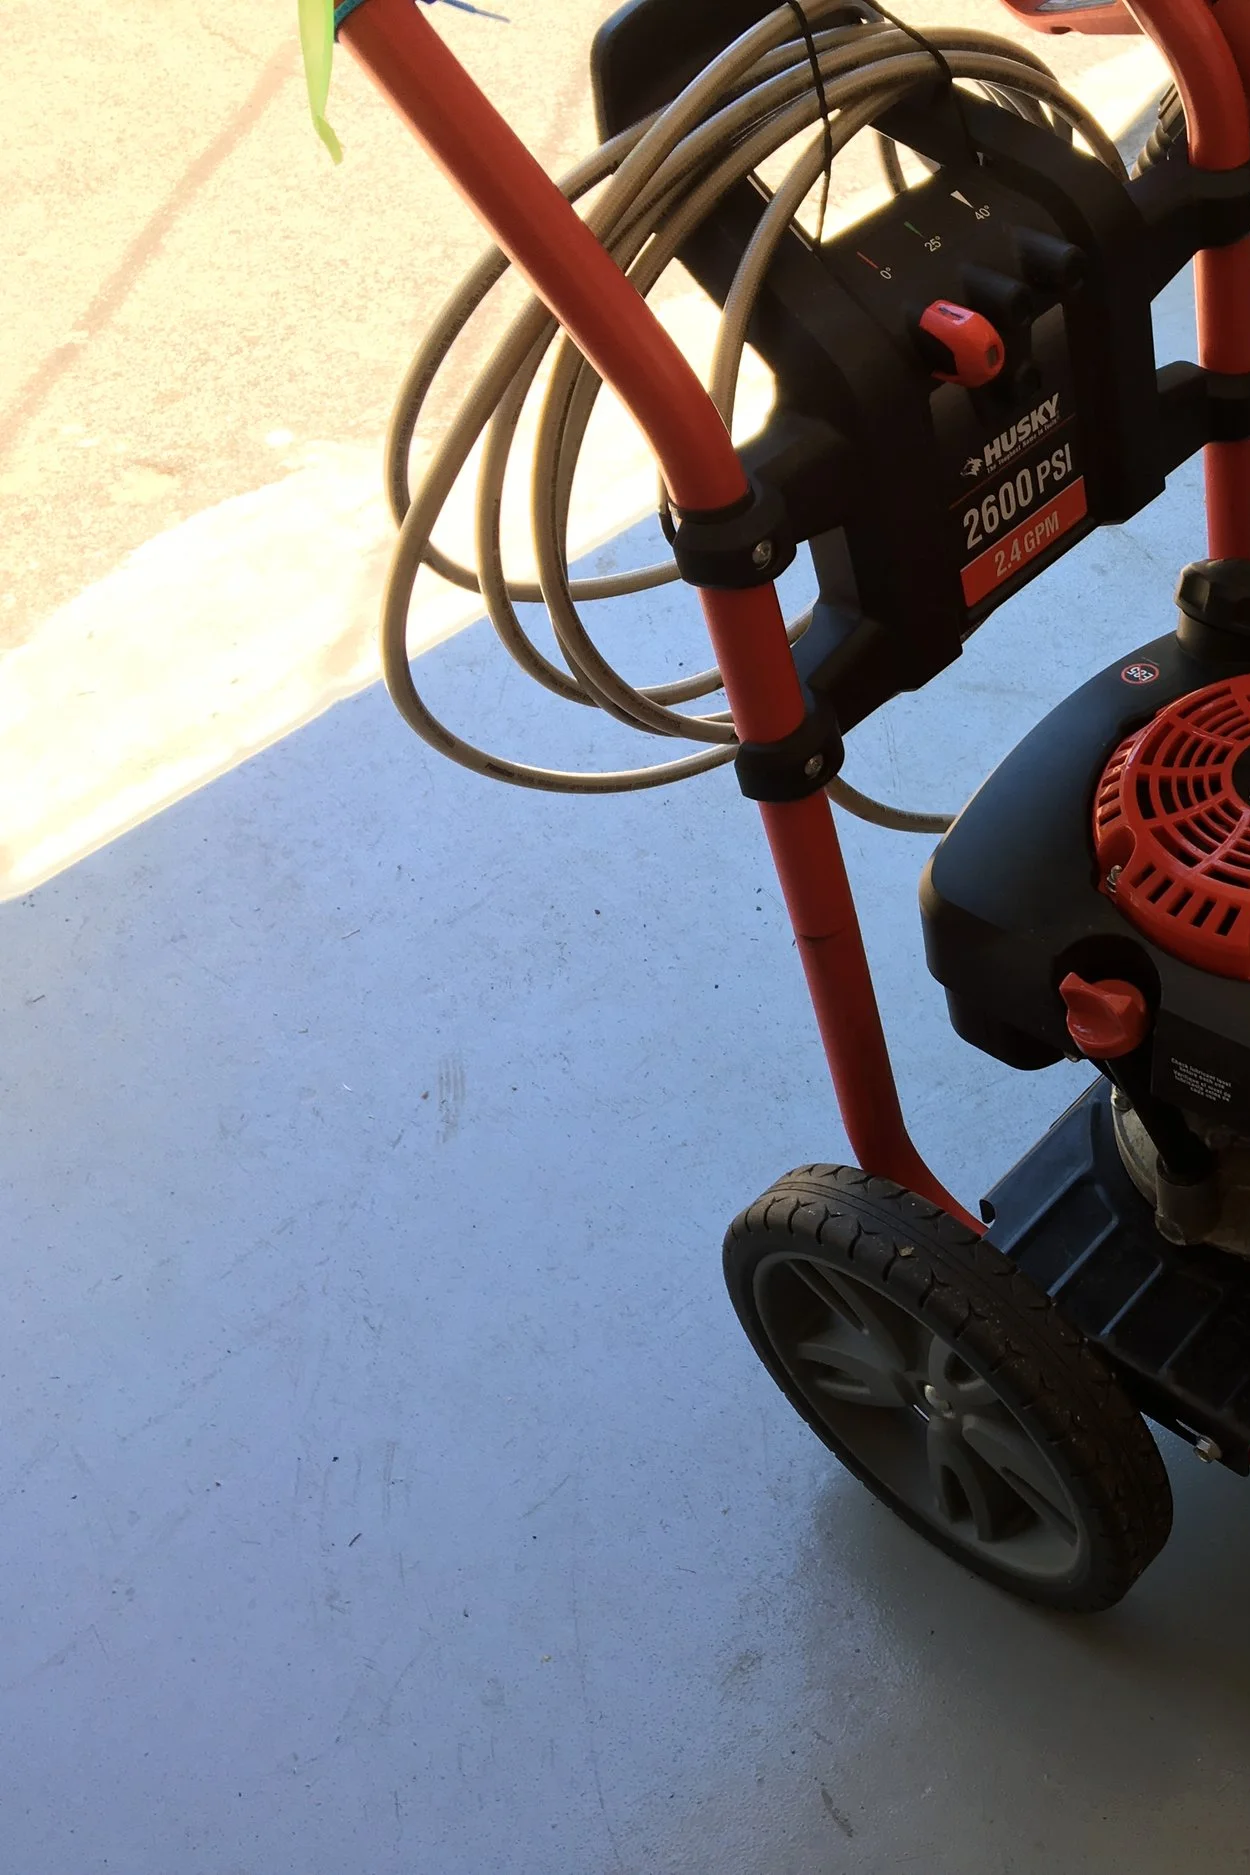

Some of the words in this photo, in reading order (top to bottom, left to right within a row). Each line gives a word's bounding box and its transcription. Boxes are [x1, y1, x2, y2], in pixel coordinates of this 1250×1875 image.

[924, 235, 942, 252] 25°
[983, 392, 1061, 468] HUSKY
[963, 468, 1033, 550] 2600
[1037, 442, 1072, 494] PSI
[994, 538, 1022, 577] 2.4
[1023, 511, 1060, 553] GPM
[1126, 666, 1155, 682] E85
